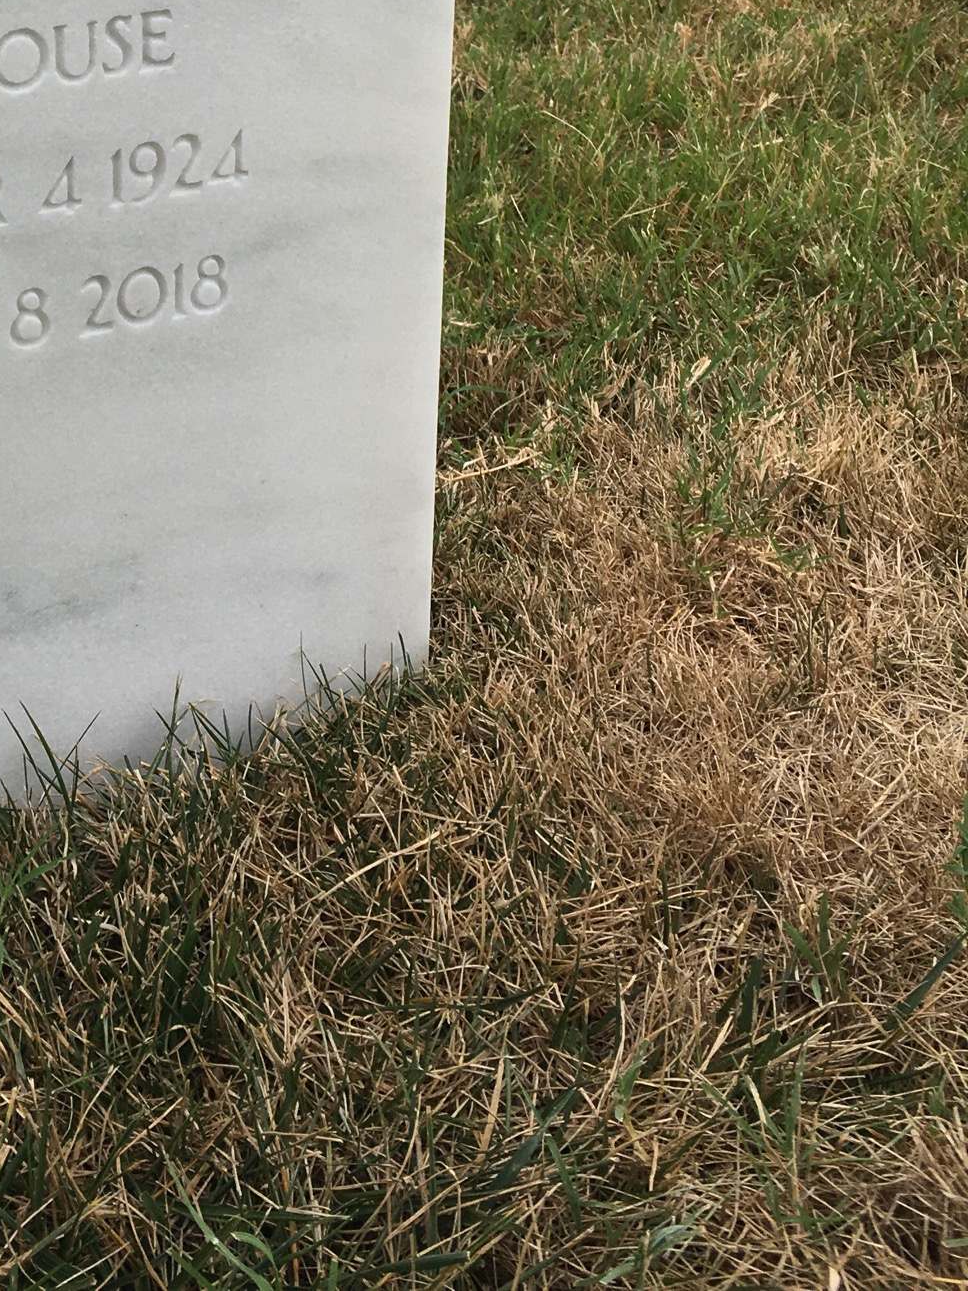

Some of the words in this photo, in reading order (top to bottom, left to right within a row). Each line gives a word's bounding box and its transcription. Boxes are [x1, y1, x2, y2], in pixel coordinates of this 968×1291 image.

[38, 155, 84, 214] 4
[109, 128, 250, 208] 1924
[9, 287, 52, 349] 8
[79, 254, 230, 338] 2018
